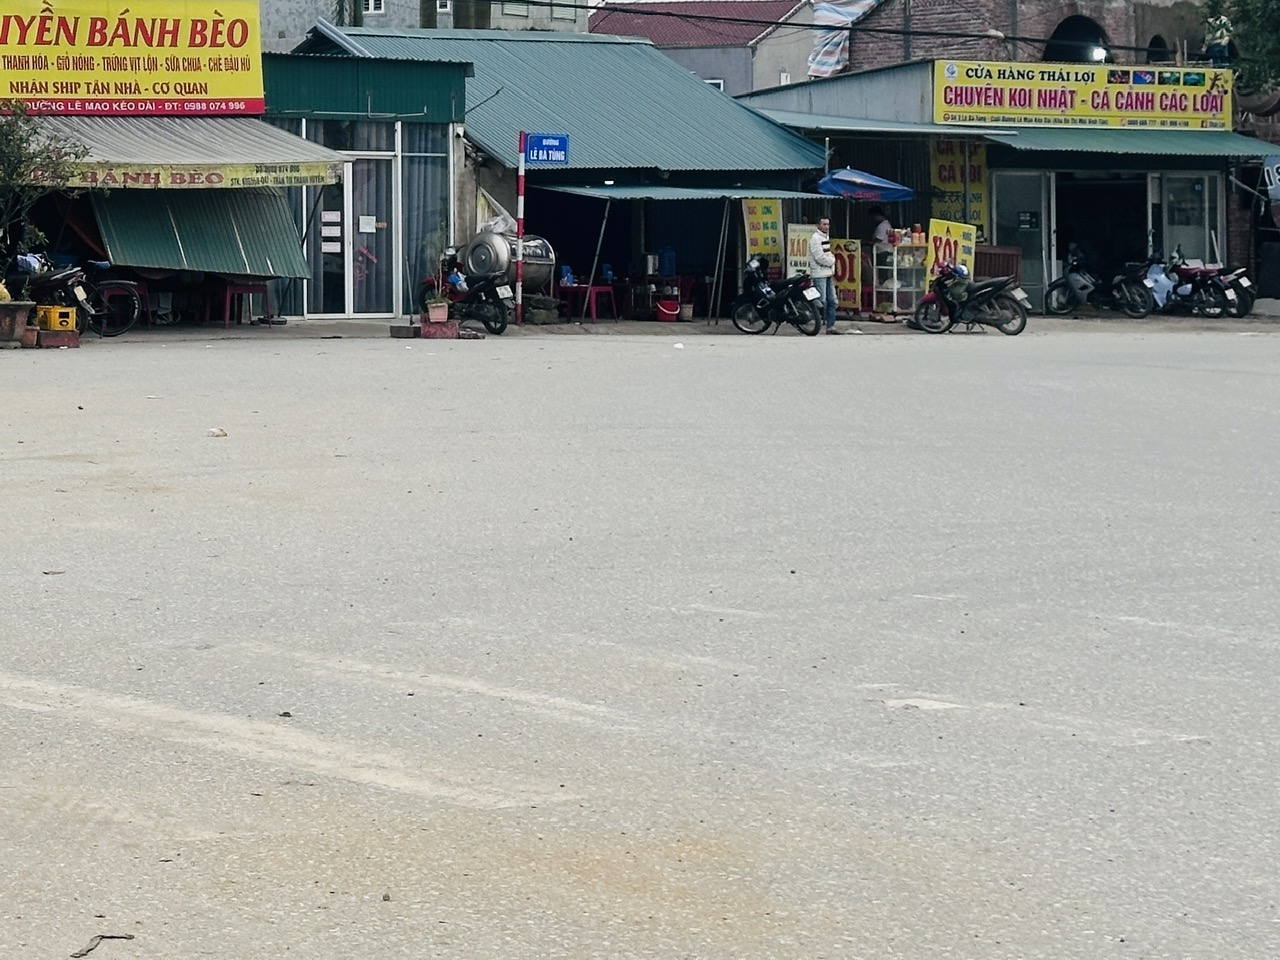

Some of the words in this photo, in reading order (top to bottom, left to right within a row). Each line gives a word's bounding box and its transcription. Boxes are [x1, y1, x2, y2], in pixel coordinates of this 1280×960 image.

[86, 8, 181, 48] BÁNH
[188, 9, 249, 48] BÈO
[2, 55, 30, 71] THANH
[72, 53, 95, 71] NÓNG
[102, 53, 127, 72] TRỨNG
[182, 56, 202, 72] CHUA
[966, 63, 993, 80] CỬA
[997, 66, 1035, 81] HÀNG
[1039, 68, 1070, 82] THÁI
[1075, 70, 1095, 86] LỢI
[9, 78, 49, 96] NHẬN
[52, 81, 81, 95] SHIP
[114, 79, 141, 95] NHÀ
[152, 82, 171, 95] CƠ
[174, 82, 208, 96] QUAN
[67, 100, 82, 111] LÊ
[85, 101, 110, 111] MAO
[112, 100, 135, 111] KÉO
[138, 100, 156, 111] DÀI
[165, 102, 181, 111] ĐT:
[184, 102, 206, 110] 0988
[210, 102, 226, 110] 074
[228, 101, 245, 110] 996
[943, 83, 1004, 107] CHUYÊN
[1009, 87, 1033, 108] KOI
[1037, 85, 1077, 114] NHẬT
[1091, 87, 1111, 110] CÁ
[1115, 85, 1155, 111] CẢNH
[1159, 88, 1187, 112] CÁC
[1192, 92, 1224, 117] LOẠI
[170, 169, 225, 185] BÈO
[834, 243, 856, 283] ÔI
